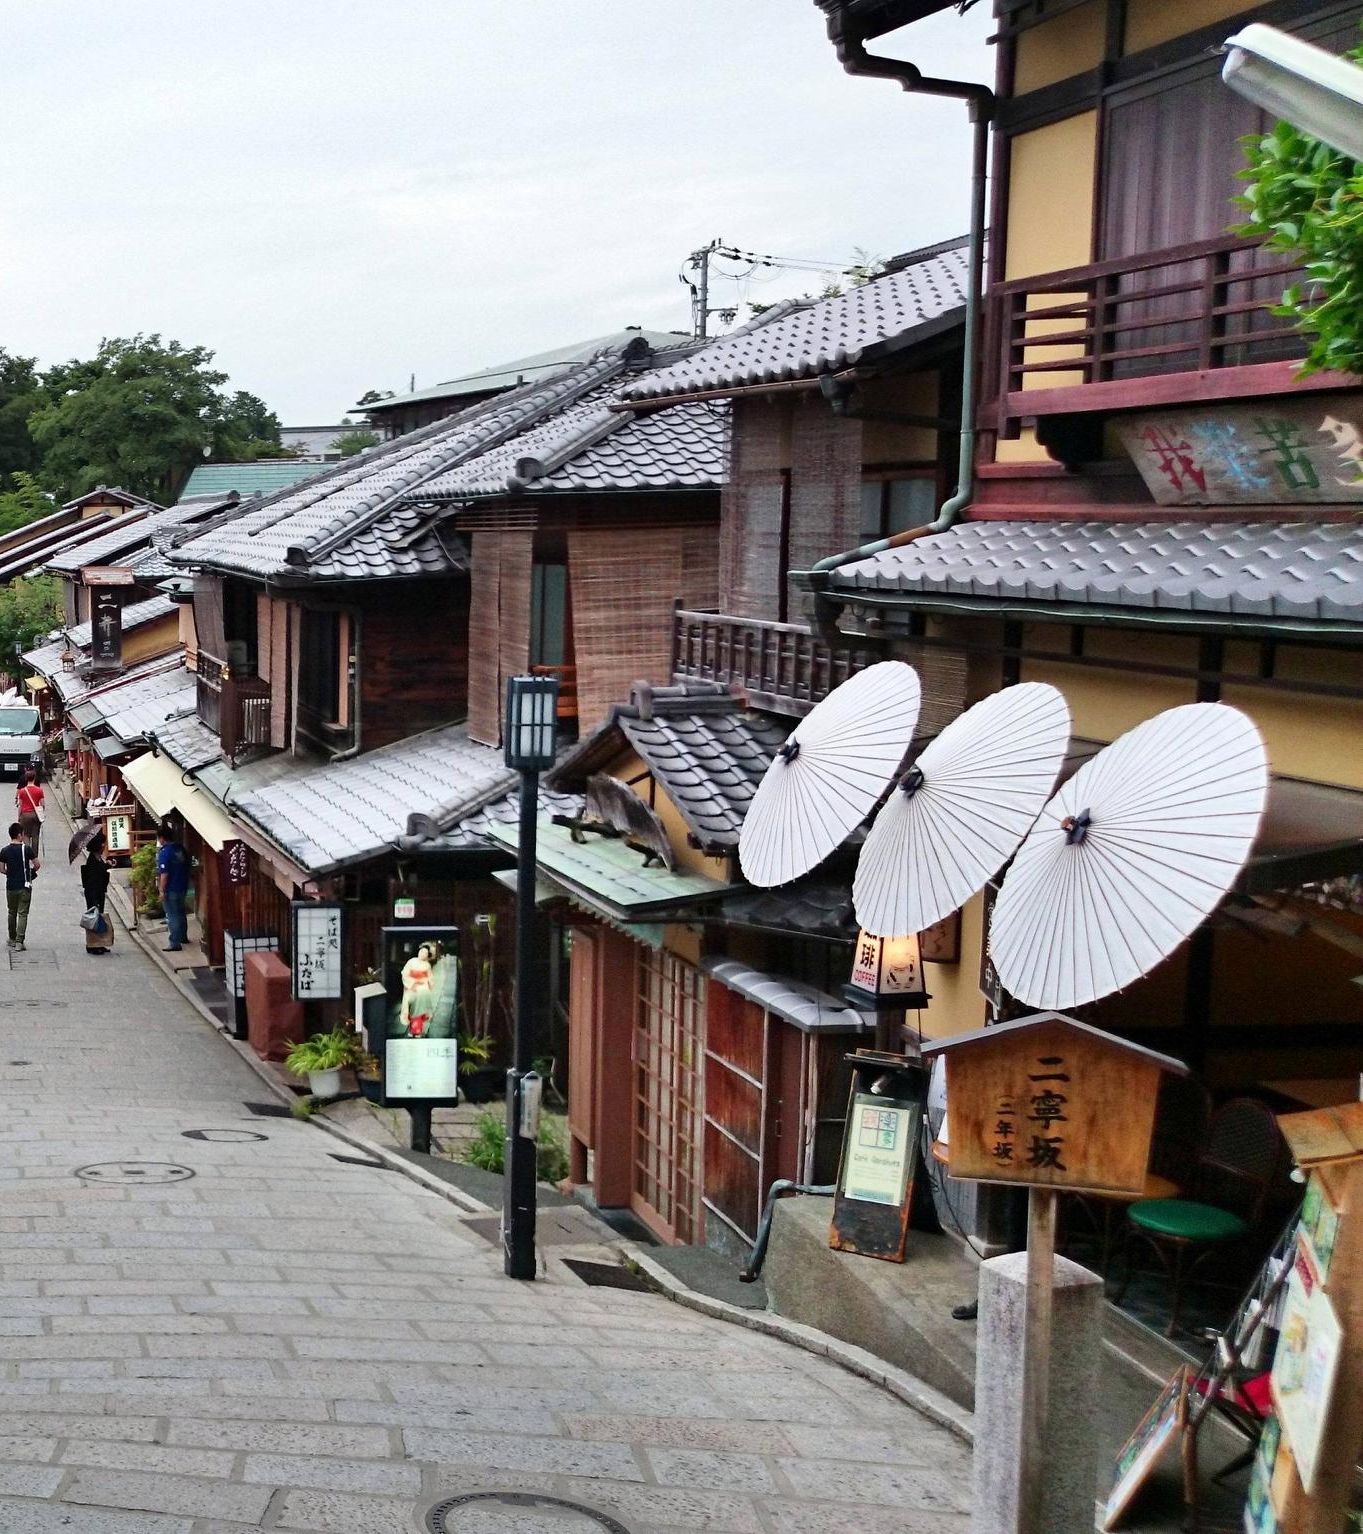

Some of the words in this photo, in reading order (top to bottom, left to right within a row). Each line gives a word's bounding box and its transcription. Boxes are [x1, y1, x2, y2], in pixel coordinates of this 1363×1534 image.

[299, 953, 314, 990] ふたば
[853, 969, 876, 987] COFFEE
[1027, 1057, 1070, 1171] 二寧坂
